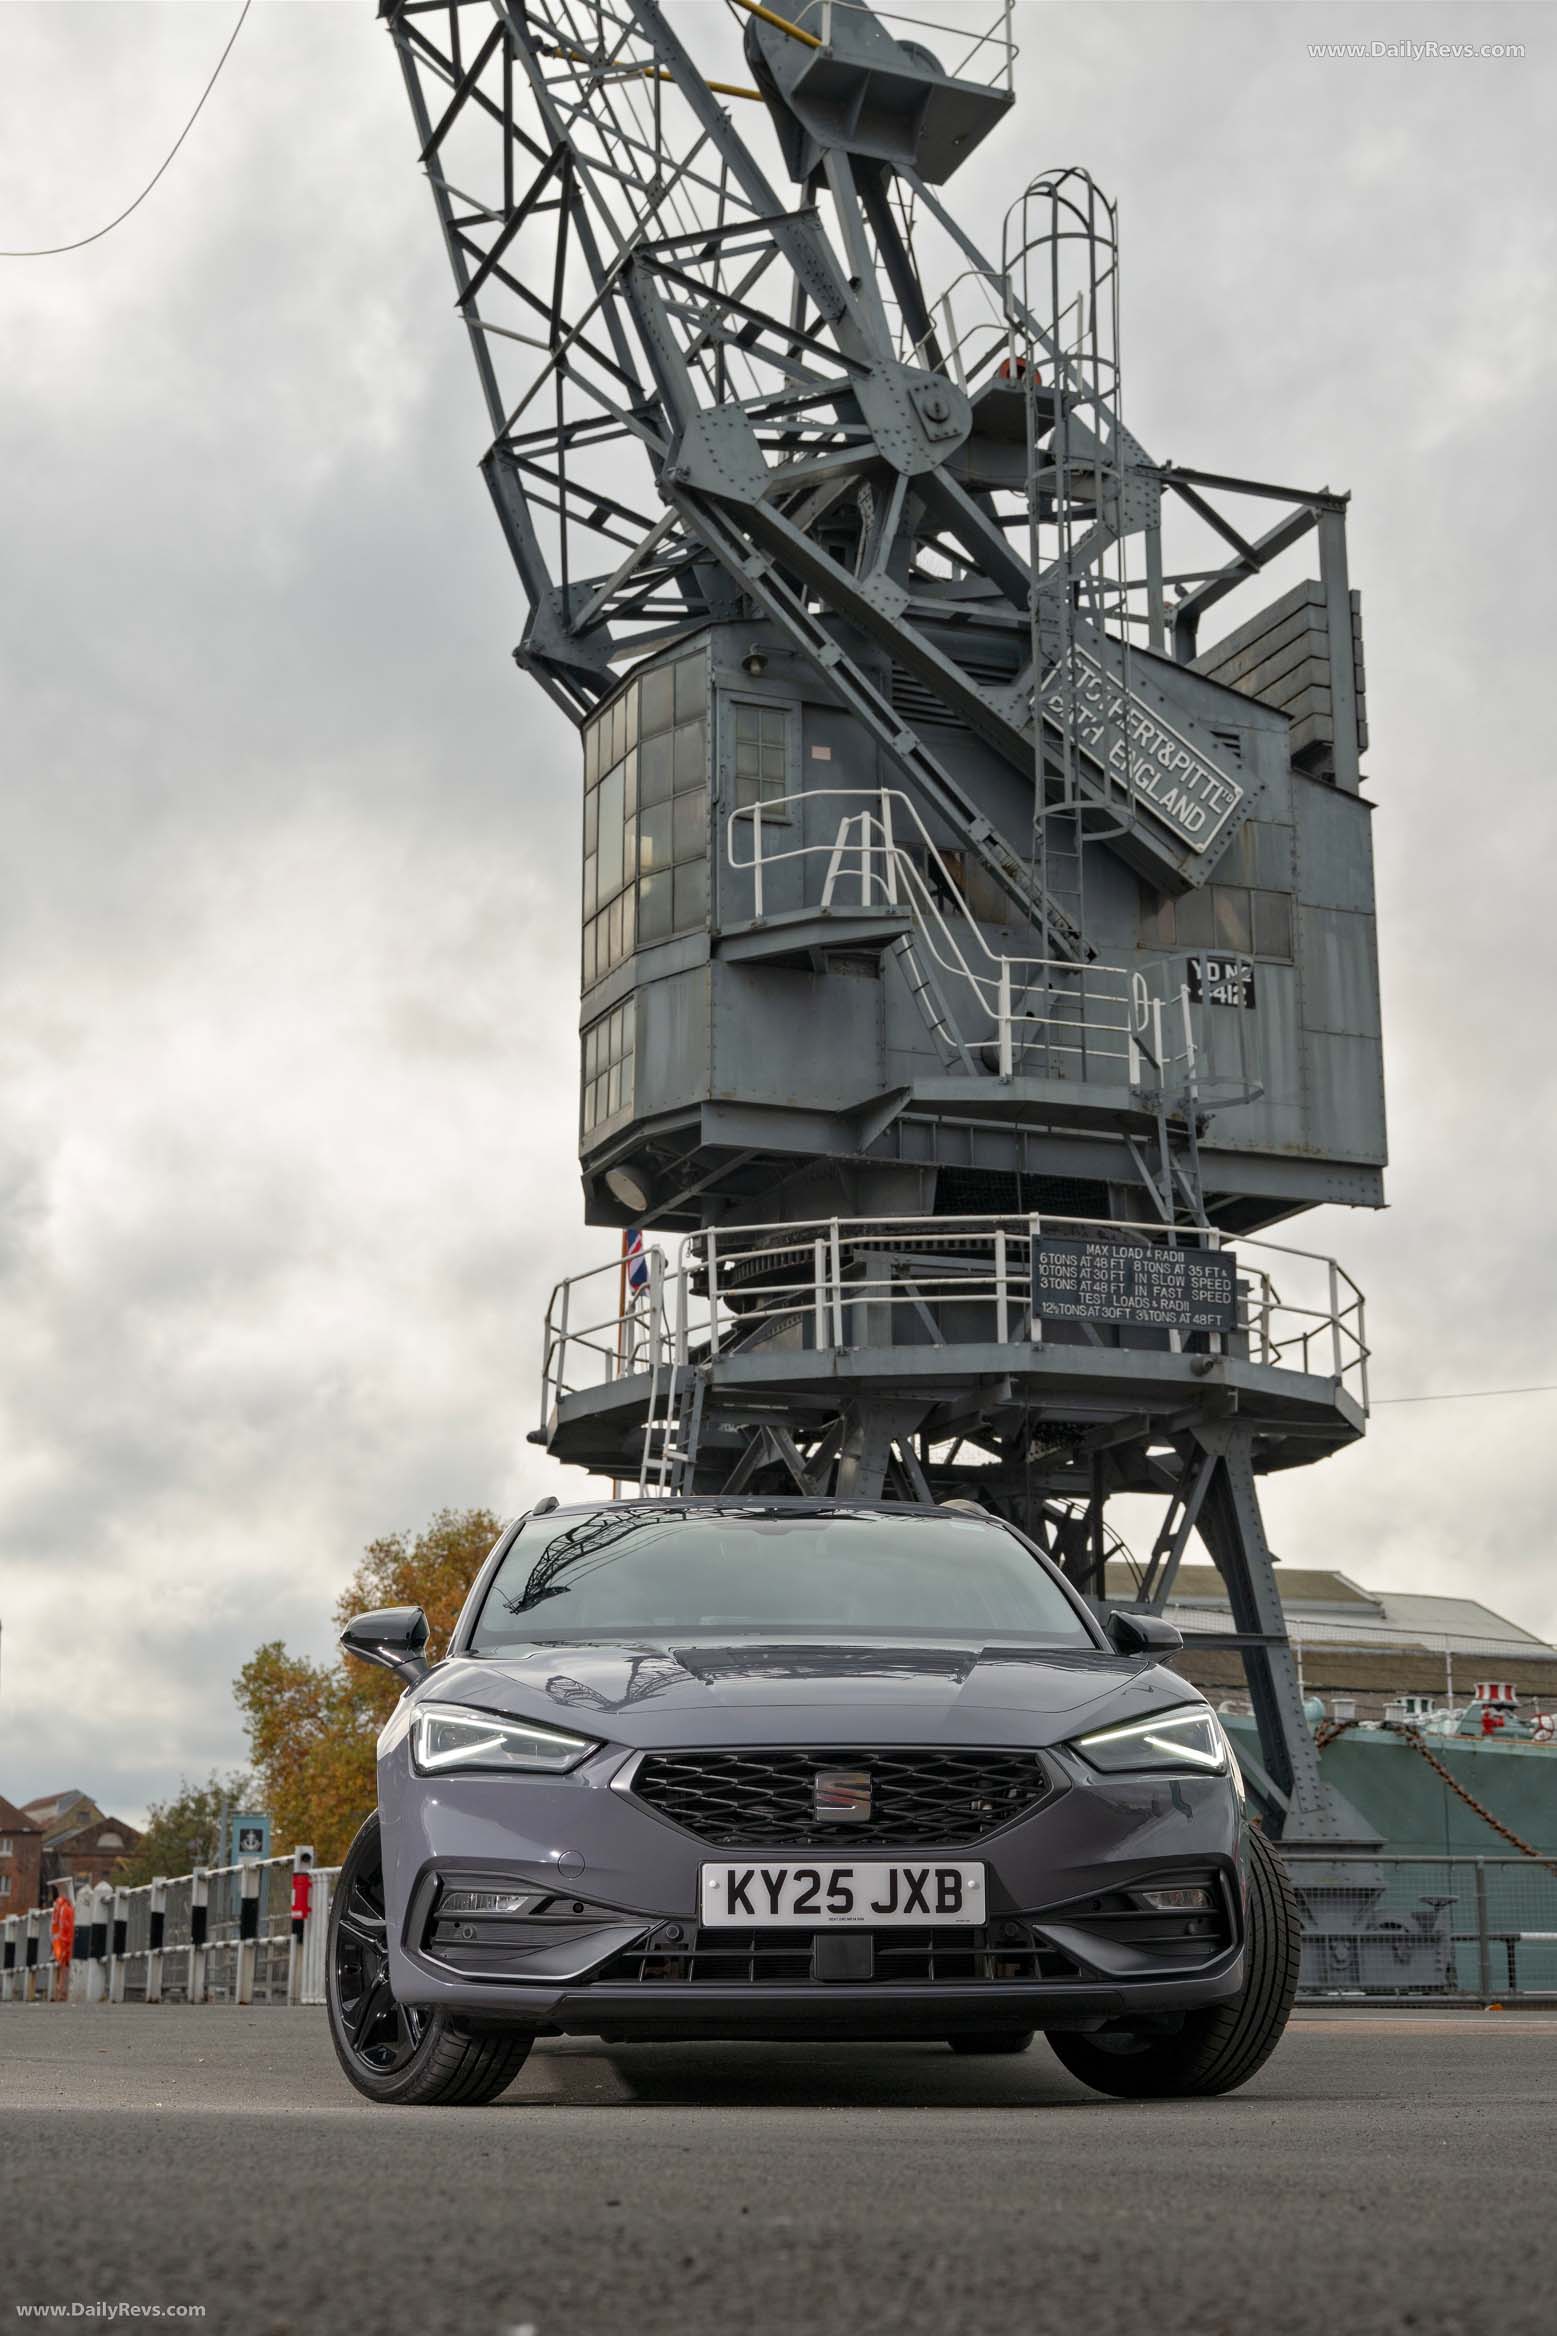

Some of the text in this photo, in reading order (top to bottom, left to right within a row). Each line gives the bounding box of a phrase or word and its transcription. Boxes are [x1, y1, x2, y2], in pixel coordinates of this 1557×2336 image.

[1108, 739, 1206, 832] ENGLAND
[1086, 1244, 1109, 1256] MAX
[1112, 1246, 1143, 1259] LOAD
[1154, 1249, 1185, 1262] RADII
[1080, 1255, 1092, 1267] AT
[1093, 1257, 1109, 1269] 48
[1110, 1258, 1126, 1270] FT
[1174, 1263, 1186, 1275] AT
[1187, 1264, 1203, 1277] 35
[1204, 1266, 1220, 1278] FT
[1080, 1267, 1092, 1279] AT
[1093, 1268, 1108, 1281] 30
[1110, 1270, 1126, 1282] FT
[1134, 1272, 1148, 1284] IN
[1151, 1273, 1185, 1287] SLOW
[1191, 1277, 1232, 1291] SPEED
[1078, 1292, 1107, 1305] TEST
[1113, 1295, 1150, 1309] LOADS
[1160, 1298, 1190, 1312] RADII
[1080, 1280, 1092, 1292] AT
[1093, 1281, 1108, 1293] 48
[1110, 1282, 1125, 1294] FT
[1134, 1285, 1148, 1297] IN
[1153, 1286, 1184, 1299] FAST
[1191, 1289, 1232, 1304] SPEED
[727, 1868, 963, 1915] KY25 JXB
